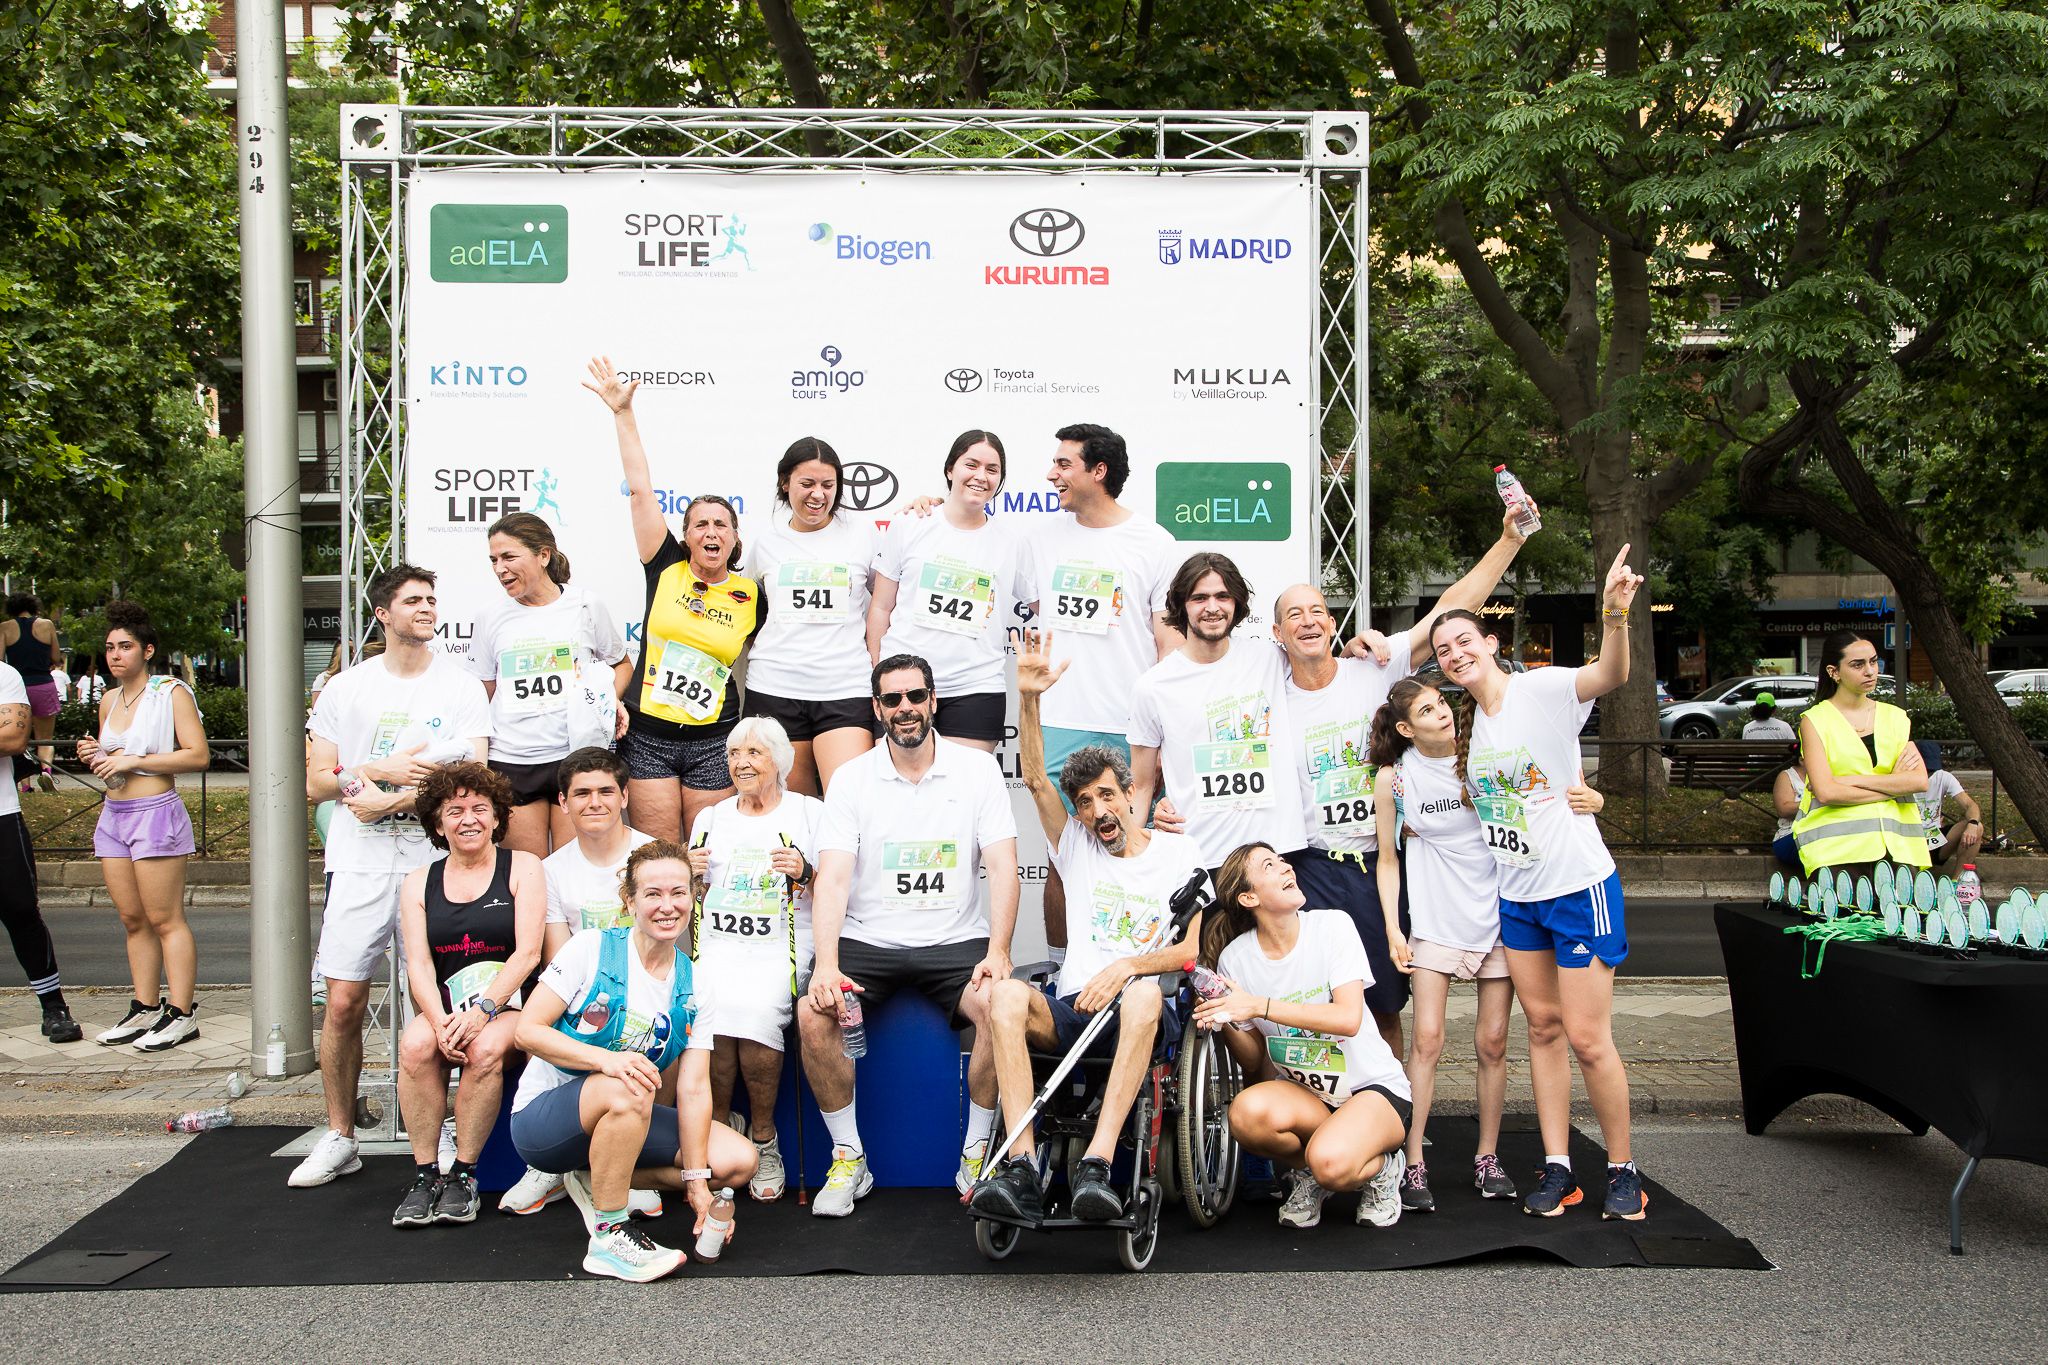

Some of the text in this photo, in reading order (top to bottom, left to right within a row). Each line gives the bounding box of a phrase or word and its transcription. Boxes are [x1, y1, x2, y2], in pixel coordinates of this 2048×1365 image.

[624, 213, 723, 236] SPORT
[449, 240, 549, 266] adELA
[638, 241, 710, 267] LIFE
[837, 235, 931, 266] Biogen
[1189, 238, 1292, 264] MADRID
[791, 370, 864, 392] amigo
[994, 368, 1034, 381] Toyota
[1174, 368, 1291, 385] MUKUA
[430, 390, 528, 400] Flexible Mobility Solutions
[792, 388, 827, 399] tours
[993, 382, 1100, 393] Financial Services
[434, 469, 535, 491] SPORT
[448, 496, 521, 522] LIFE
[653, 489, 744, 515] Bion
[1175, 498, 1272, 524] adELA
[792, 589, 833, 609] 541
[928, 594, 974, 621] 542
[1057, 594, 1099, 619] 539
[1839, 598, 1878, 609] Sanitas
[1766, 622, 1803, 632] Centro
[1807, 621, 1820, 631] de
[514, 674, 563, 700] 540
[662, 670, 713, 710] 1282
[1202, 772, 1265, 798] 1280
[896, 872, 945, 895] 544
[711, 912, 771, 936] 1283
[788, 912, 796, 953] FIZAN
[1285, 1045, 1330, 1068] ELA
